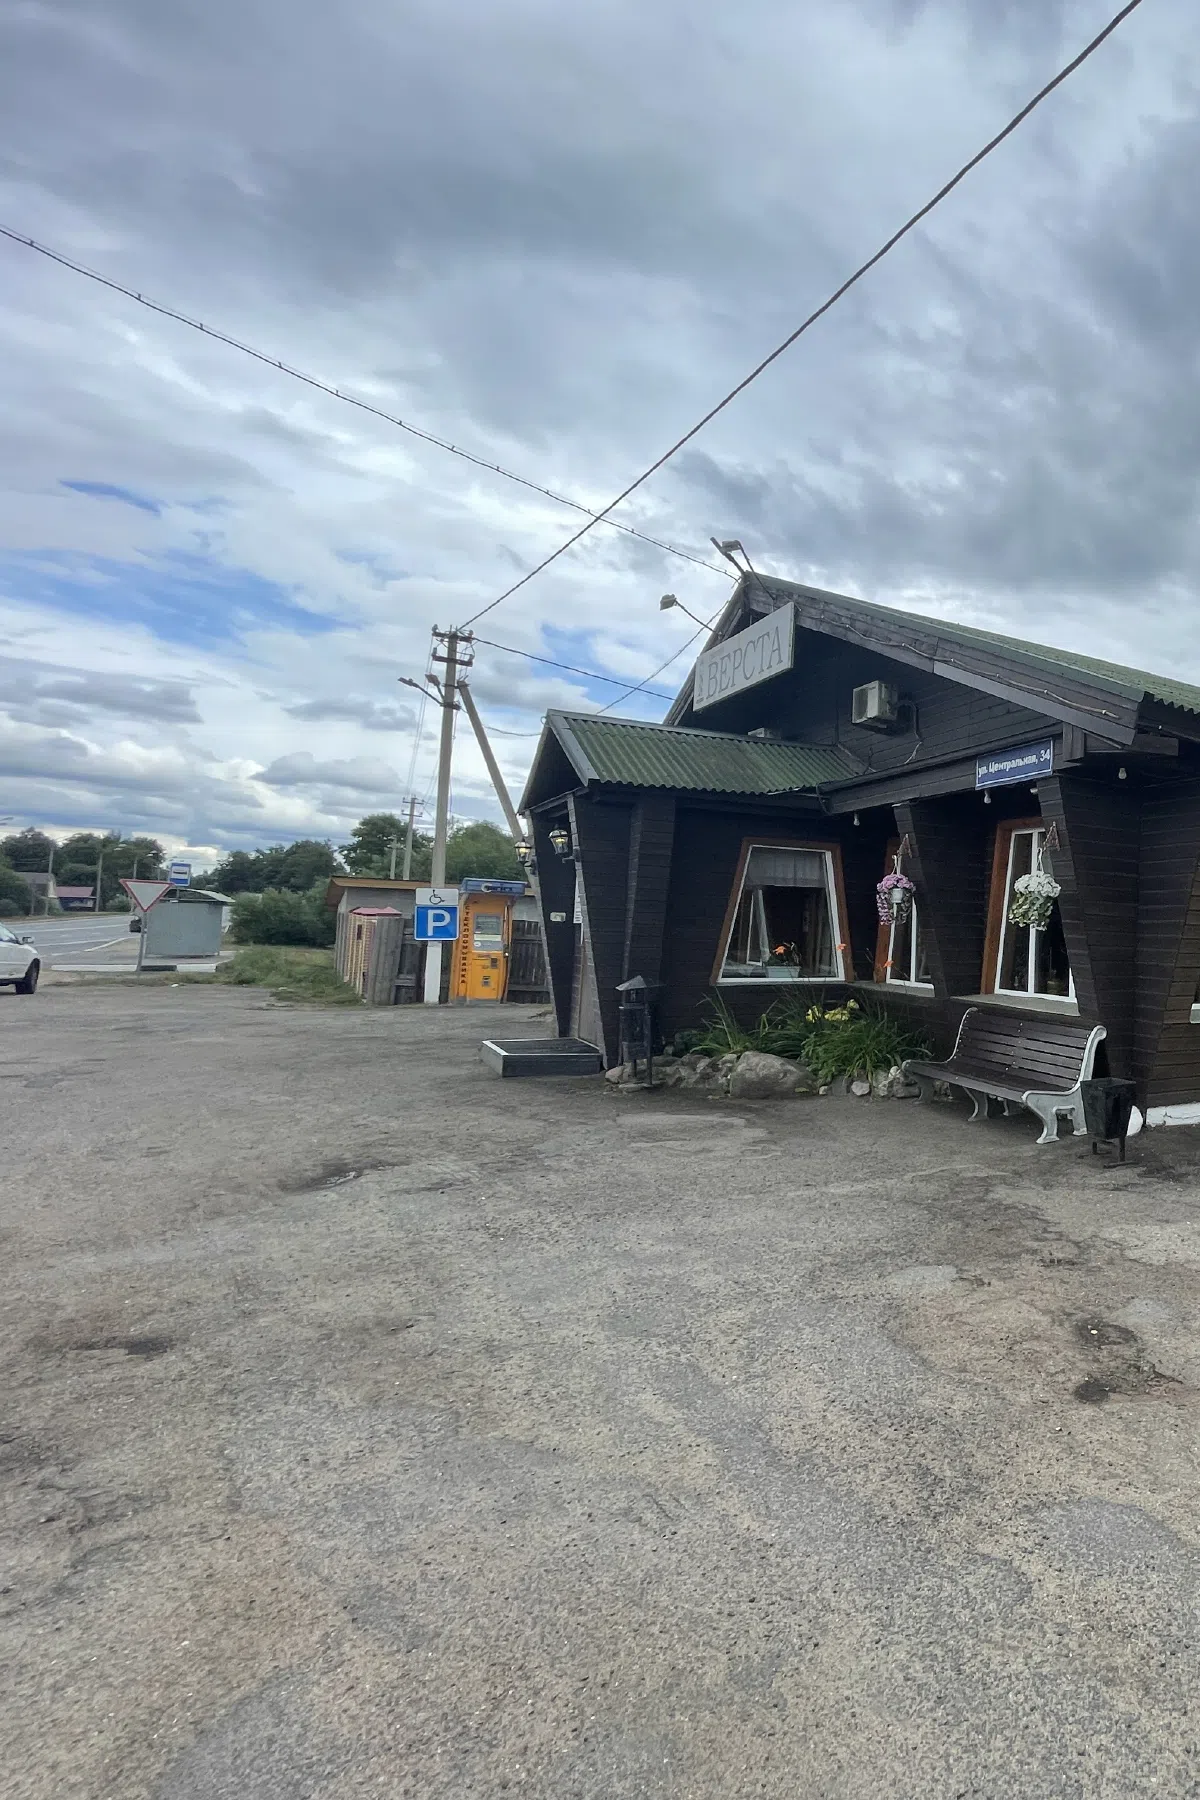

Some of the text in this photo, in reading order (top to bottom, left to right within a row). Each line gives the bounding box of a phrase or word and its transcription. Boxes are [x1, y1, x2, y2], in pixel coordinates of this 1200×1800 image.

[706, 626, 783, 699] ВЕРСТА
[978, 749, 1050, 777] ул. Центральная, 34
[428, 910, 450, 936] P
